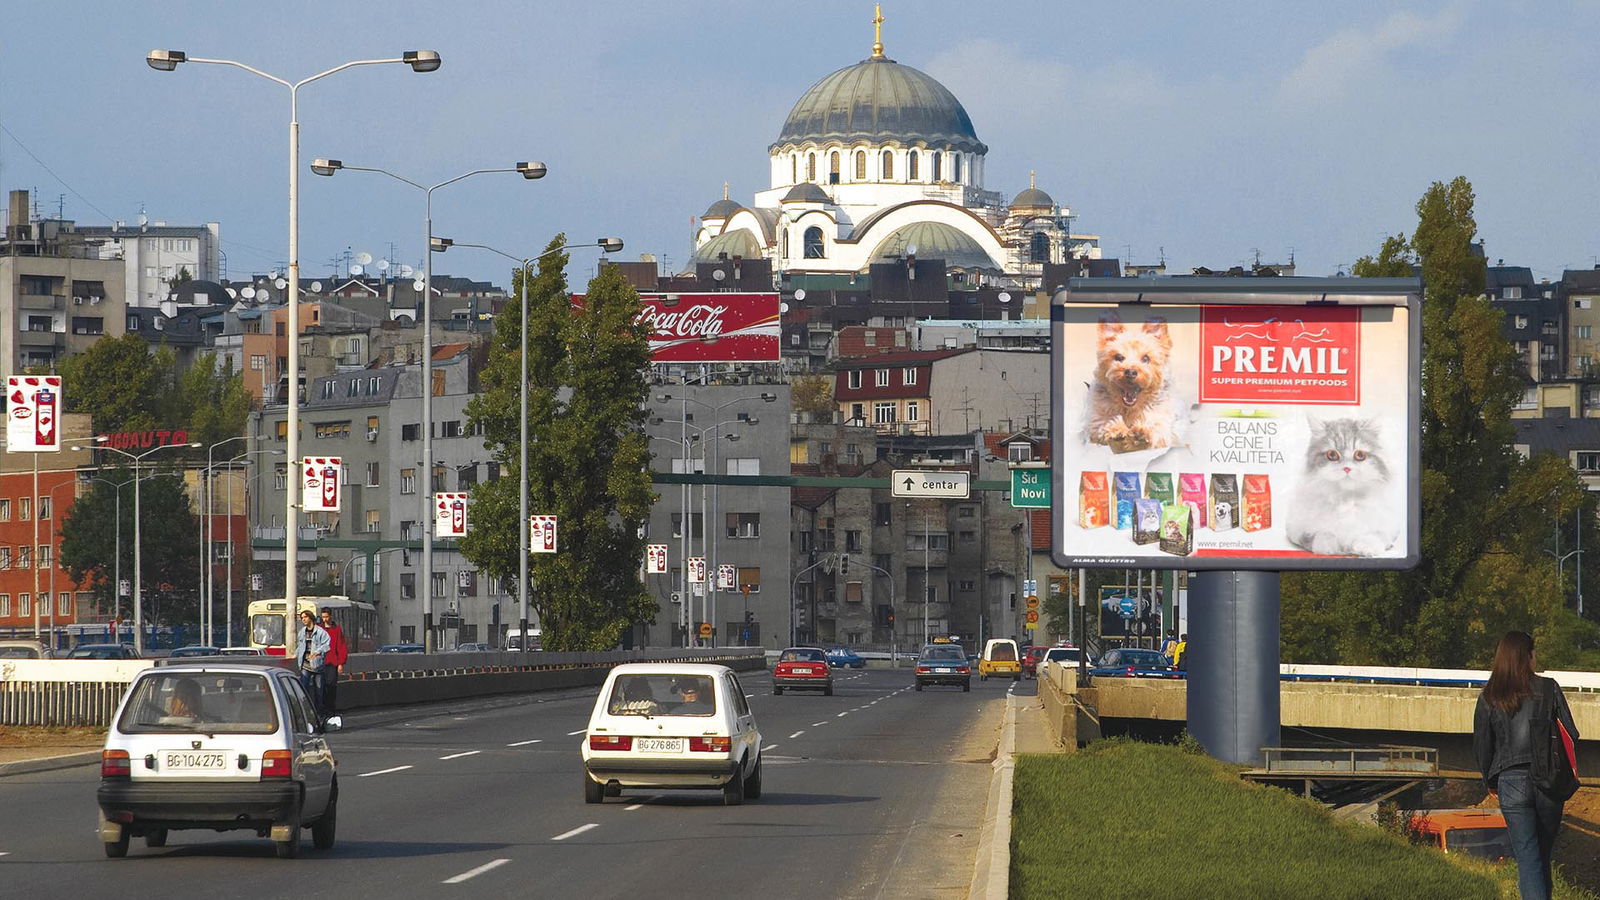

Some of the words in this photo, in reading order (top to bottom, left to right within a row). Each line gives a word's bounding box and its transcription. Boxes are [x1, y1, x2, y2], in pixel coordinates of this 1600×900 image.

[1212, 345, 1348, 374] PREMIL
[1211, 377, 1243, 385] SUPER
[1245, 378, 1293, 386] PREMIUM
[1294, 379, 1348, 387] PETFOODS
[1218, 421, 1278, 435] BALANS
[1222, 435, 1264, 449] CENE
[1268, 436, 1272, 449] I
[1210, 450, 1285, 463] KVALITETA
[1021, 471, 1038, 484] Šid
[922, 480, 958, 490] centar
[1021, 487, 1046, 499] Novi
